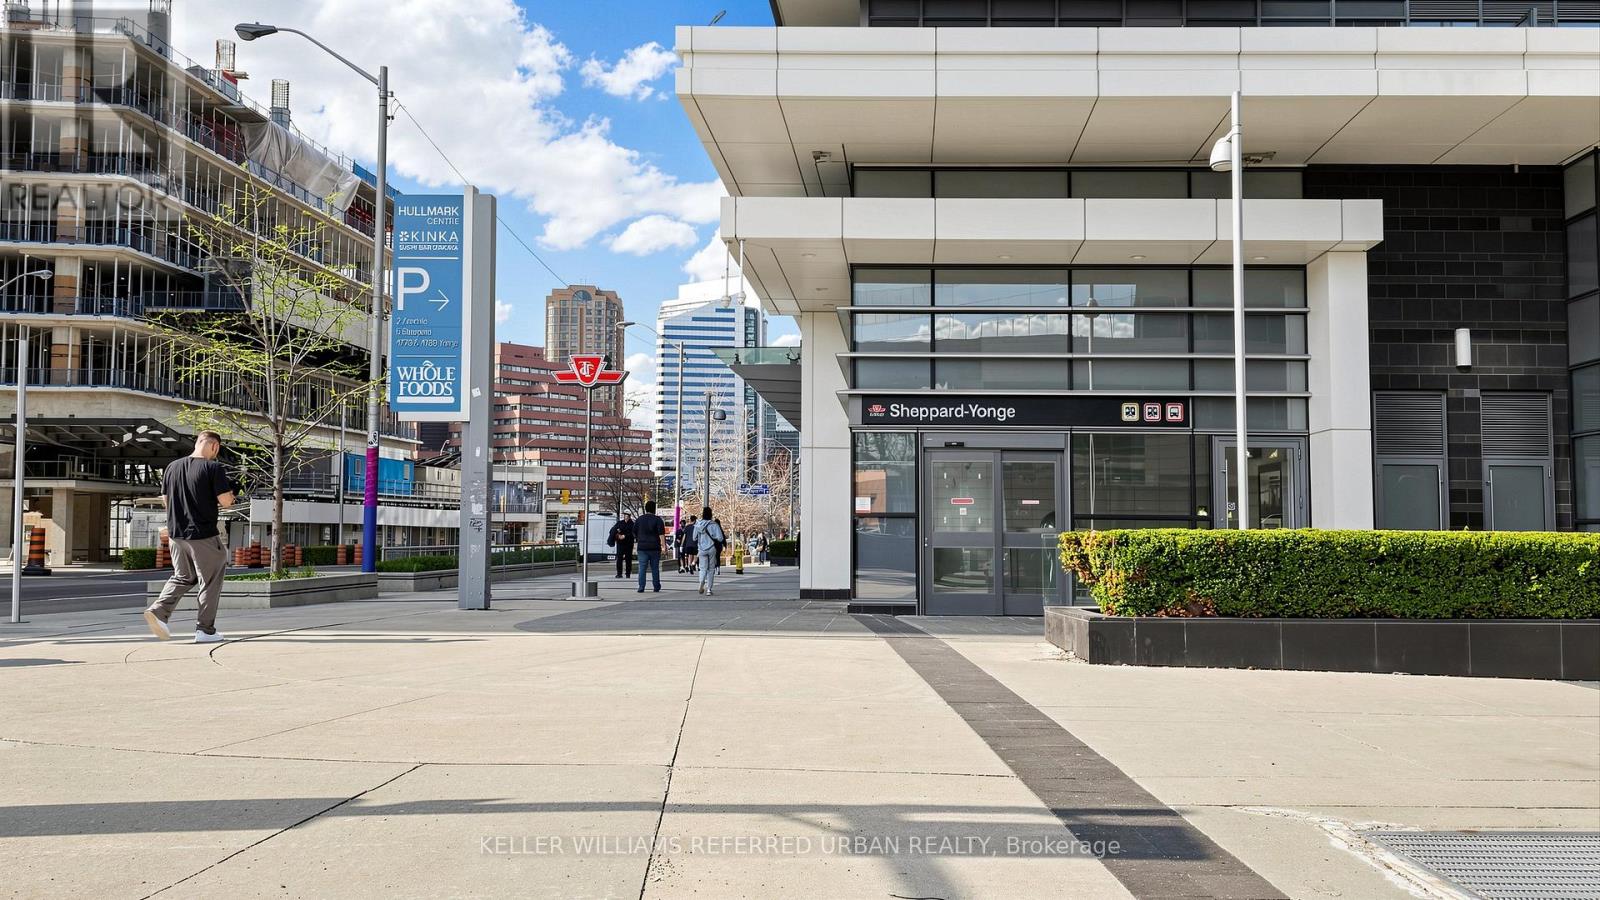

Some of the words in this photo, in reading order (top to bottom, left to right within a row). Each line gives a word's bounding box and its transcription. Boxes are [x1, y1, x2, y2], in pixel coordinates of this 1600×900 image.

[398, 206, 459, 216] HULLMARK
[411, 231, 459, 241] KINKA
[397, 267, 430, 311] P
[396, 366, 456, 381] WHOLE
[399, 381, 453, 396] FOODS
[889, 403, 1016, 421] Sheppard-Yonge
